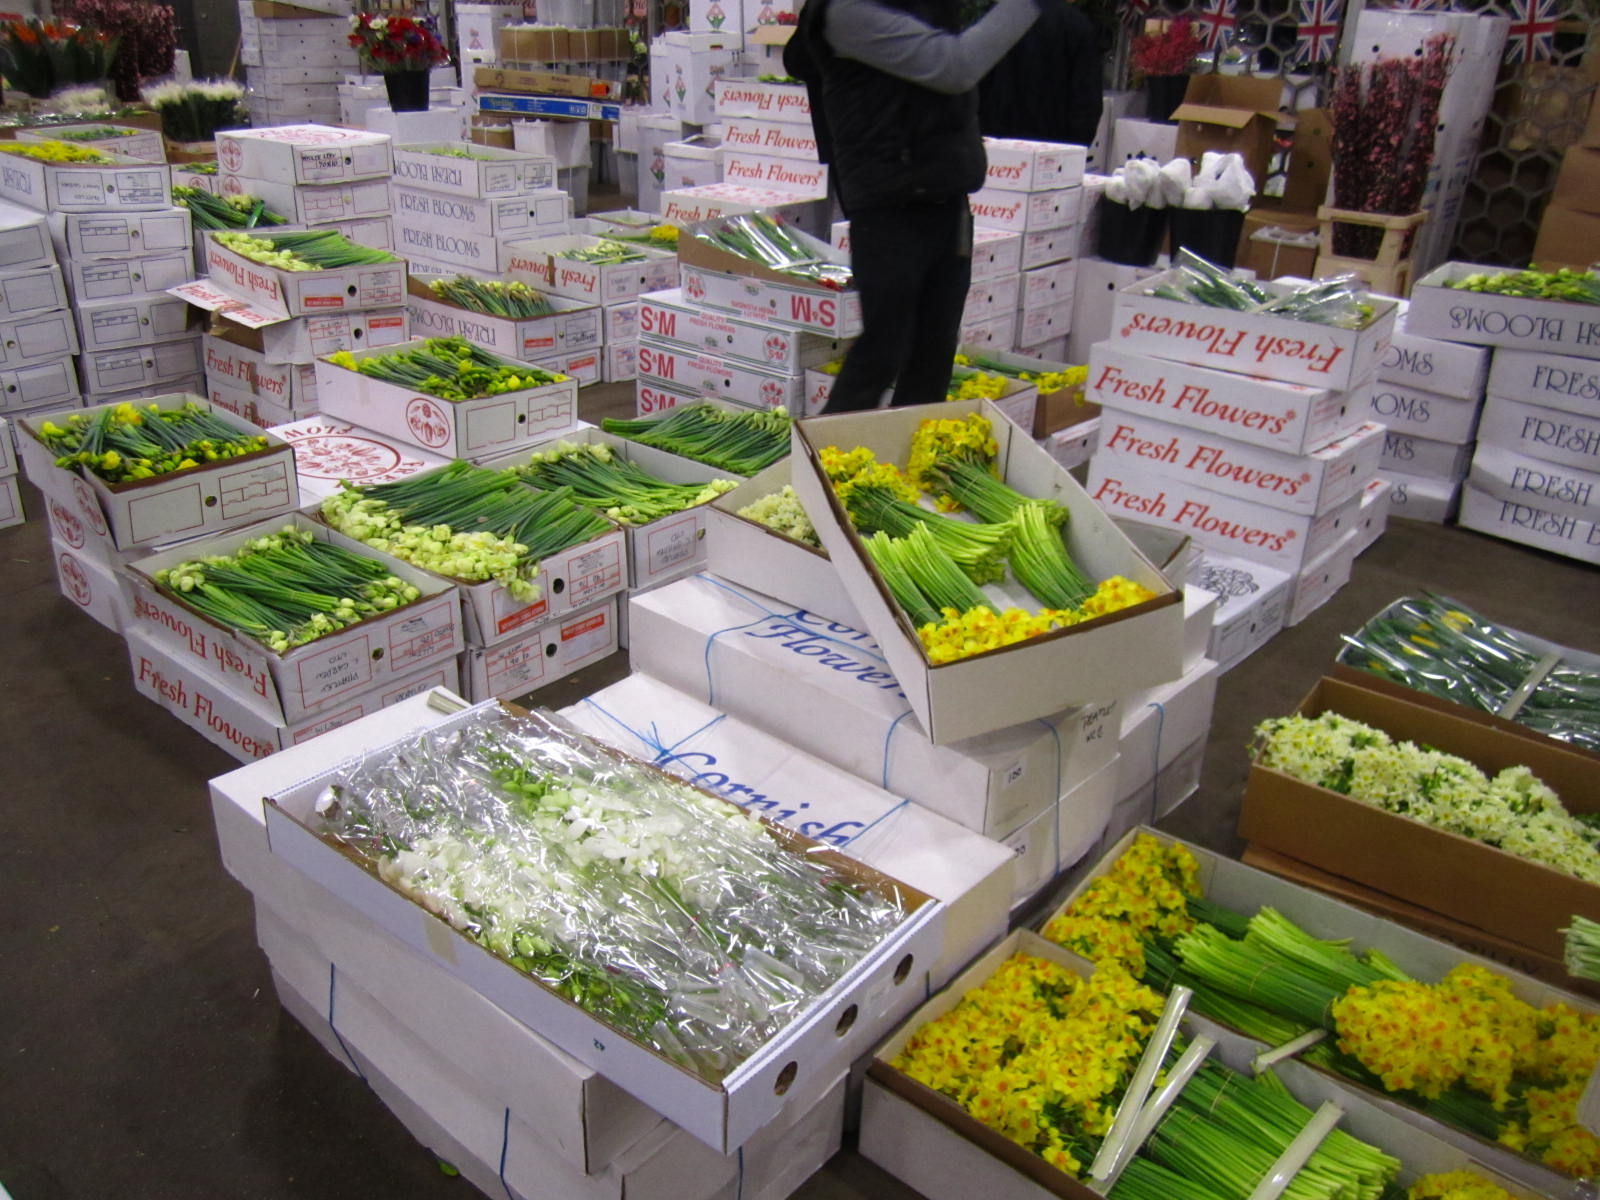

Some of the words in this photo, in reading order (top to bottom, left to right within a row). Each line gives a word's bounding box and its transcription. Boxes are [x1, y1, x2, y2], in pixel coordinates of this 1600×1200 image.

[722, 89, 773, 109] Flowers
[725, 126, 760, 142] Fresh
[764, 129, 816, 150] Flowers
[397, 160, 428, 181] BLOO
[431, 164, 462, 186] FRESH
[727, 160, 763, 177] Fresh
[766, 164, 819, 186] Flowers
[987, 163, 1022, 180] wers
[400, 193, 429, 213] FRESH
[433, 200, 476, 222] BLOOMS
[665, 202, 701, 219] Fresh
[970, 203, 1017, 220] owers
[403, 227, 433, 248] FRESH
[436, 234, 480, 257] BLOOMS
[210, 252, 245, 286] Flowers
[511, 257, 553, 283] lowers
[562, 268, 597, 293] Fresh
[248, 271, 278, 301] Fresh
[641, 306, 676, 337] S&M
[791, 295, 836, 327] S&M
[1449, 306, 1563, 341] BLOOMS
[459, 320, 496, 346] FRESH
[1130, 313, 1248, 356] Flowers
[207, 348, 234, 376] Fresh
[639, 348, 674, 379] S&M
[1256, 334, 1344, 373] Fresh
[1381, 345, 1433, 376] OMS
[1532, 365, 1600, 400] FRES
[1094, 365, 1166, 404] Fresh
[1172, 385, 1290, 435] Flowers
[1371, 392, 1431, 423] OMS
[1521, 416, 1600, 456] FRESH
[1106, 424, 1180, 464] Fresh
[1185, 445, 1304, 496] Flowers
[1510, 466, 1593, 507] FRESH
[1093, 478, 1166, 518] Fresh
[1172, 500, 1290, 551] Flowers
[1500, 501, 1577, 539] FRESH
[135, 595, 206, 658] Flowers
[213, 641, 268, 699] Fresh
[744, 624, 907, 699] Flower
[138, 657, 188, 710] Fresh
